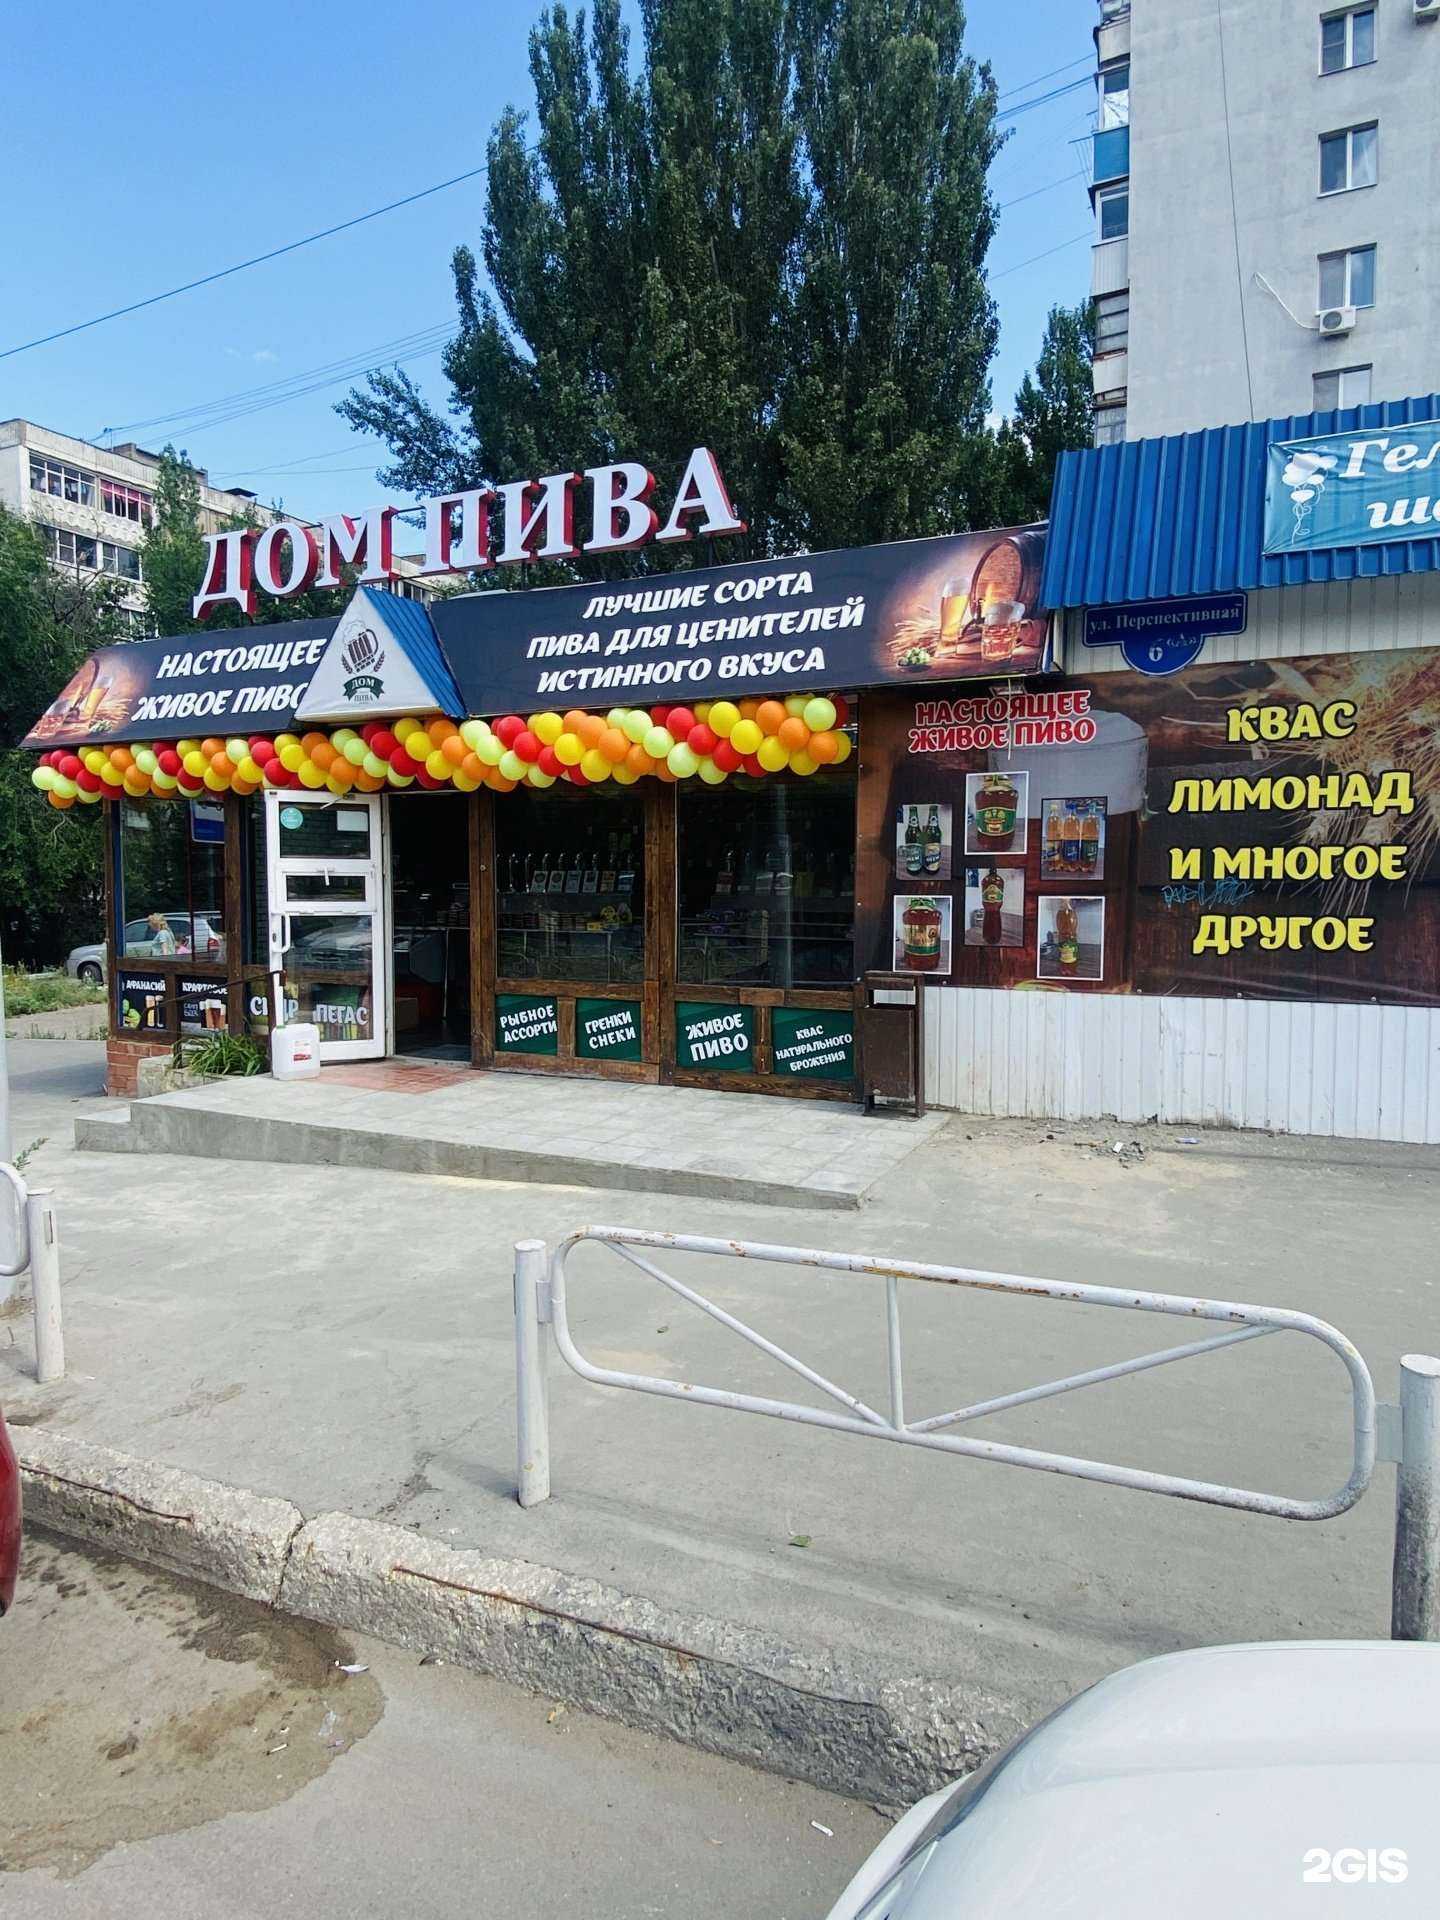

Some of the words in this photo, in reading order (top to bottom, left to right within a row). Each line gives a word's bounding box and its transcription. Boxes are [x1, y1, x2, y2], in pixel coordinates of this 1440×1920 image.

[1366, 495, 1440, 529] ш
[194, 505, 396, 620] ДОМ
[416, 447, 746, 574] ПИВА
[583, 583, 709, 619] ЛУЧШИЕ
[713, 570, 813, 606] СОРТА
[526, 631, 599, 659] ПИВА
[604, 621, 675, 657] ДЛЯ
[676, 595, 866, 649] ЦЕНИТЕЛЕЙ
[1090, 620, 1111, 635] ул.
[1116, 606, 1240, 631] Перспективная
[156, 637, 327, 679] НАСТОЯЩЕЕ
[536, 656, 715, 693] ИСТИННОГО
[718, 646, 826, 679] ВКУСА
[351, 677, 375, 689] ДОМ
[131, 689, 233, 722] ЖИВОЕ
[914, 689, 1092, 727] НАСТОЯЩЕЕ
[907, 722, 1009, 753] ЖИВОЕ
[1013, 716, 1097, 746] ПИВО
[1227, 701, 1357, 743] КВАС
[1167, 770, 1415, 815] ЛИМОНАД
[1170, 847, 1202, 881] И
[1212, 844, 1408, 881] МНОГОЕ
[1192, 914, 1375, 955] ДРУГОЕ
[126, 979, 166, 992] АФАНАСИЙ
[315, 1003, 369, 1026] ПЕГАС
[500, 1005, 555, 1029] РЫБНОЕ
[584, 1010, 632, 1034] ГРЕНКИ
[685, 1012, 744, 1041] ЖИВОЕ
[503, 1020, 558, 1044] АССОРТИ
[588, 1026, 636, 1050] СНЕКИ
[690, 1032, 749, 1062] ПИВО
[775, 1032, 853, 1060] НАТУРАЛЬНОГО
[796, 1024, 824, 1041] КВАС
[789, 1050, 846, 1072] БРОЖЕНИЯ
